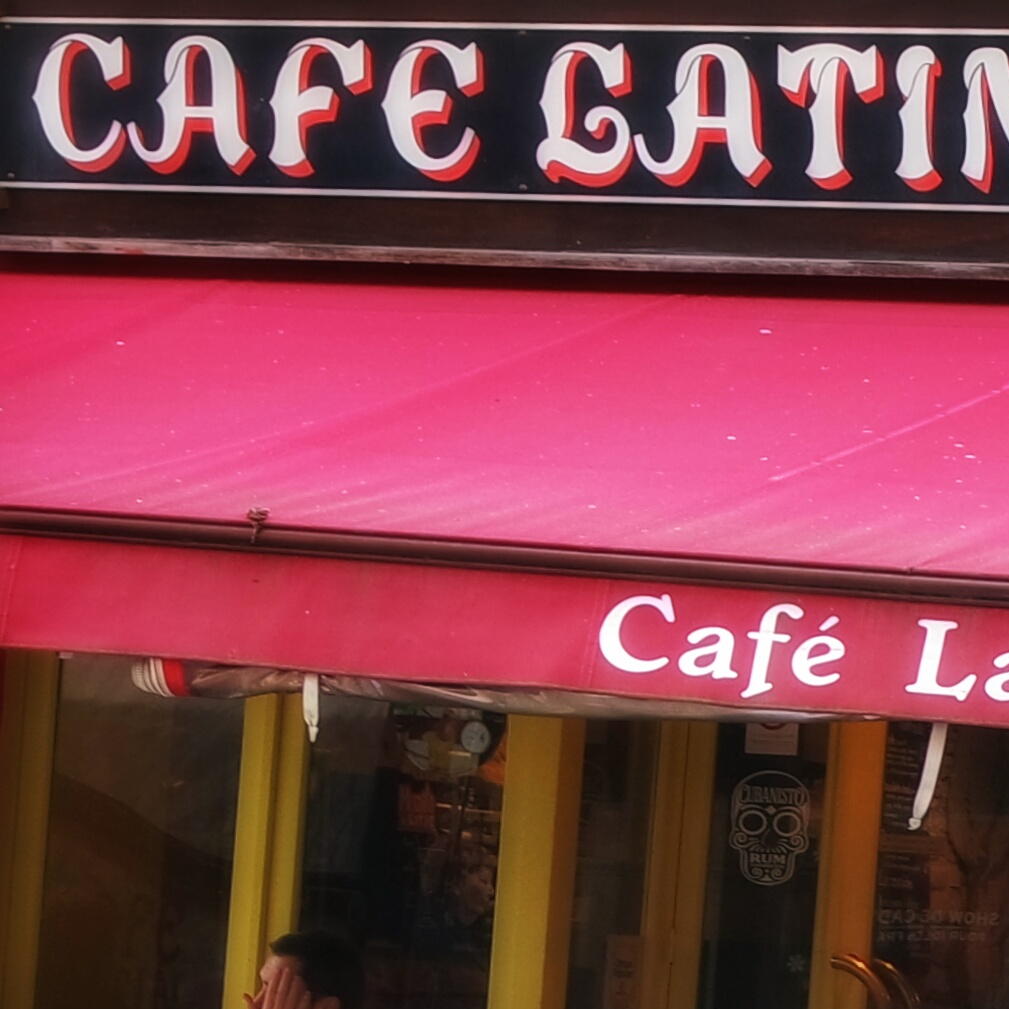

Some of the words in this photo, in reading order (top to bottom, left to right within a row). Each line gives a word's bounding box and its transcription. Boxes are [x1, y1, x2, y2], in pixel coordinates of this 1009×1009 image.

[32, 33, 484, 182] CAFE
[598, 594, 846, 698] Café
[739, 784, 805, 807] CUBANISTO
[750, 853, 786, 864] RUM
